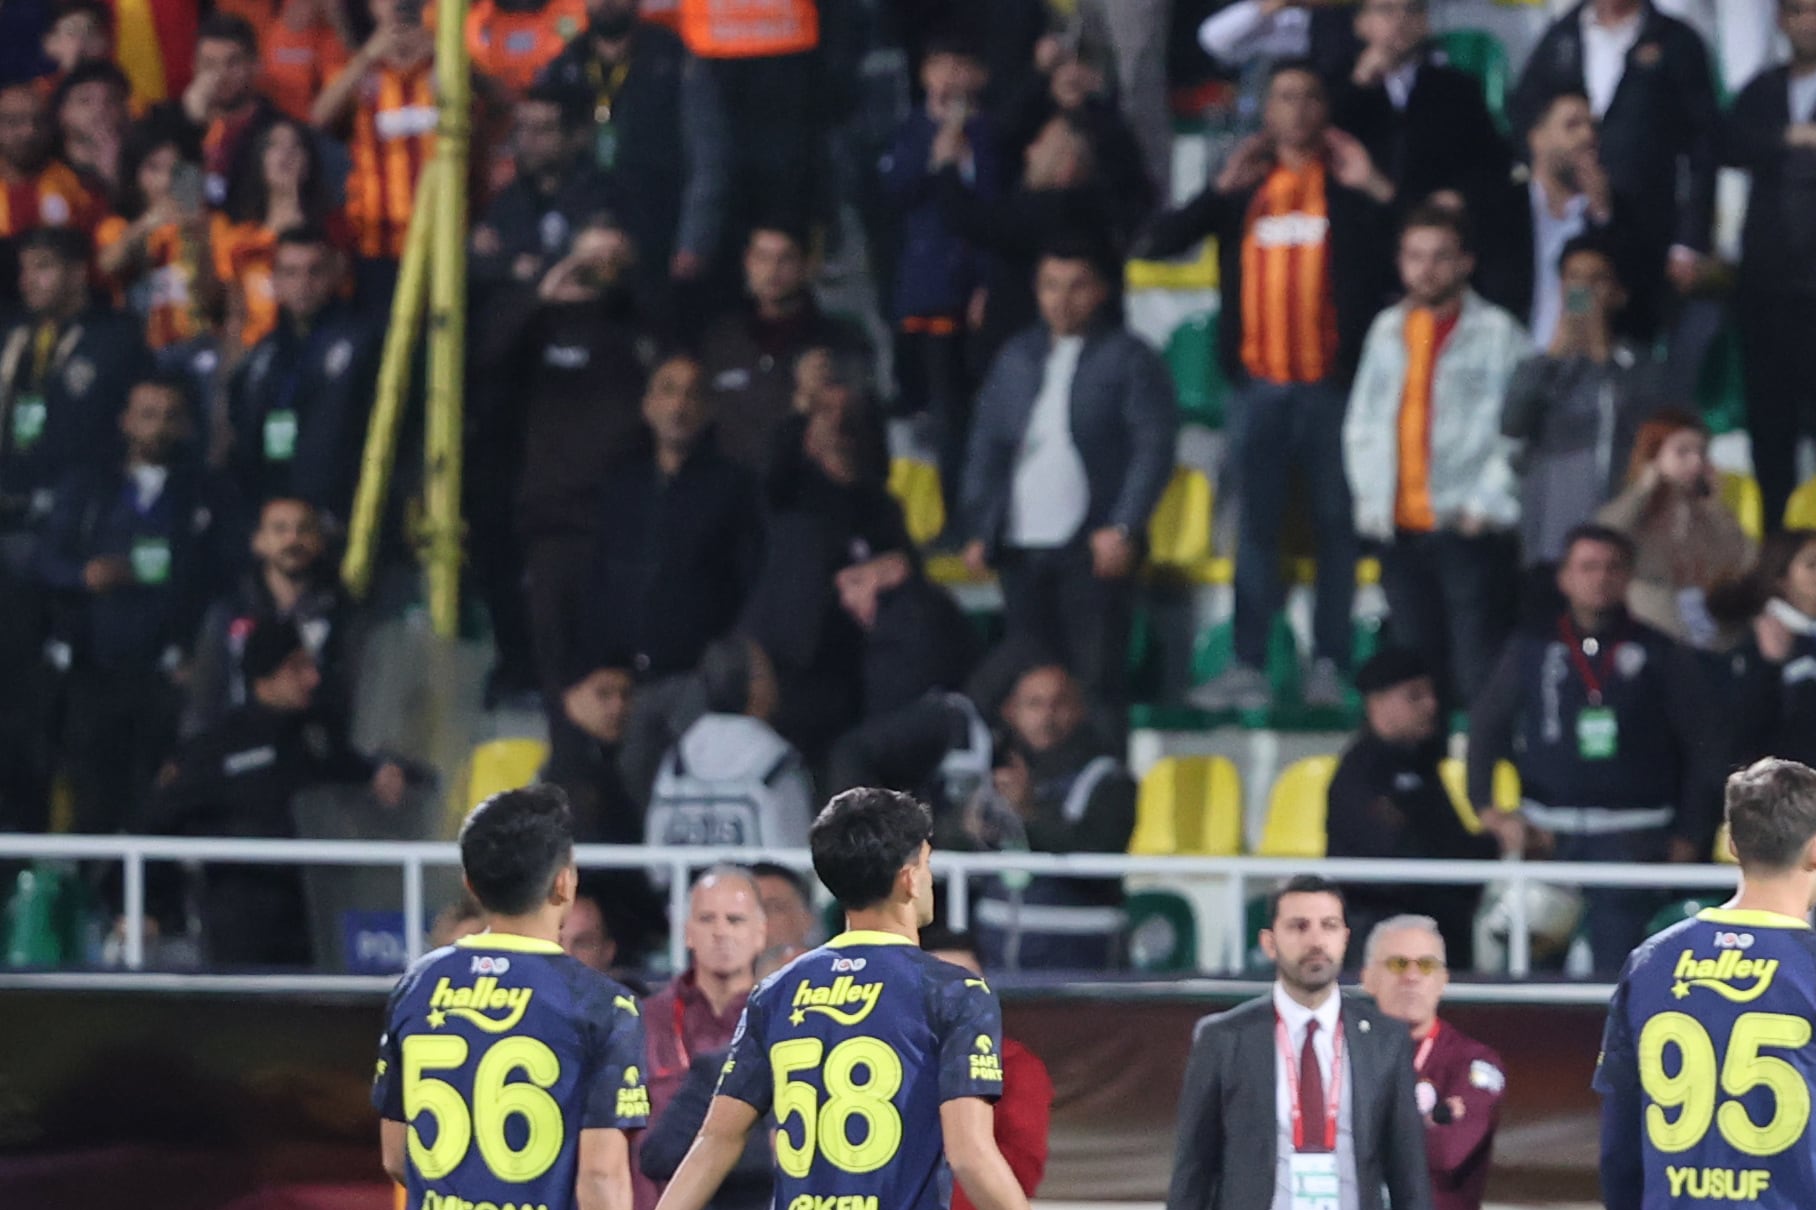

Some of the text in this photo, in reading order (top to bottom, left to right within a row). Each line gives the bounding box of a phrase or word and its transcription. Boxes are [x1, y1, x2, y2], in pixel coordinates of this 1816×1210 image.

[831, 957, 867, 972] 100
[1714, 931, 1755, 949] 100
[789, 975, 884, 1026] halley
[1671, 949, 1780, 1003] halley
[427, 976, 533, 1033] halley
[970, 1068, 1003, 1081] PORT
[1639, 1012, 1812, 1156] 95
[402, 1034, 562, 1182] 56
[770, 1035, 902, 1178] 58
[1666, 1165, 1771, 1201] YUSUF
